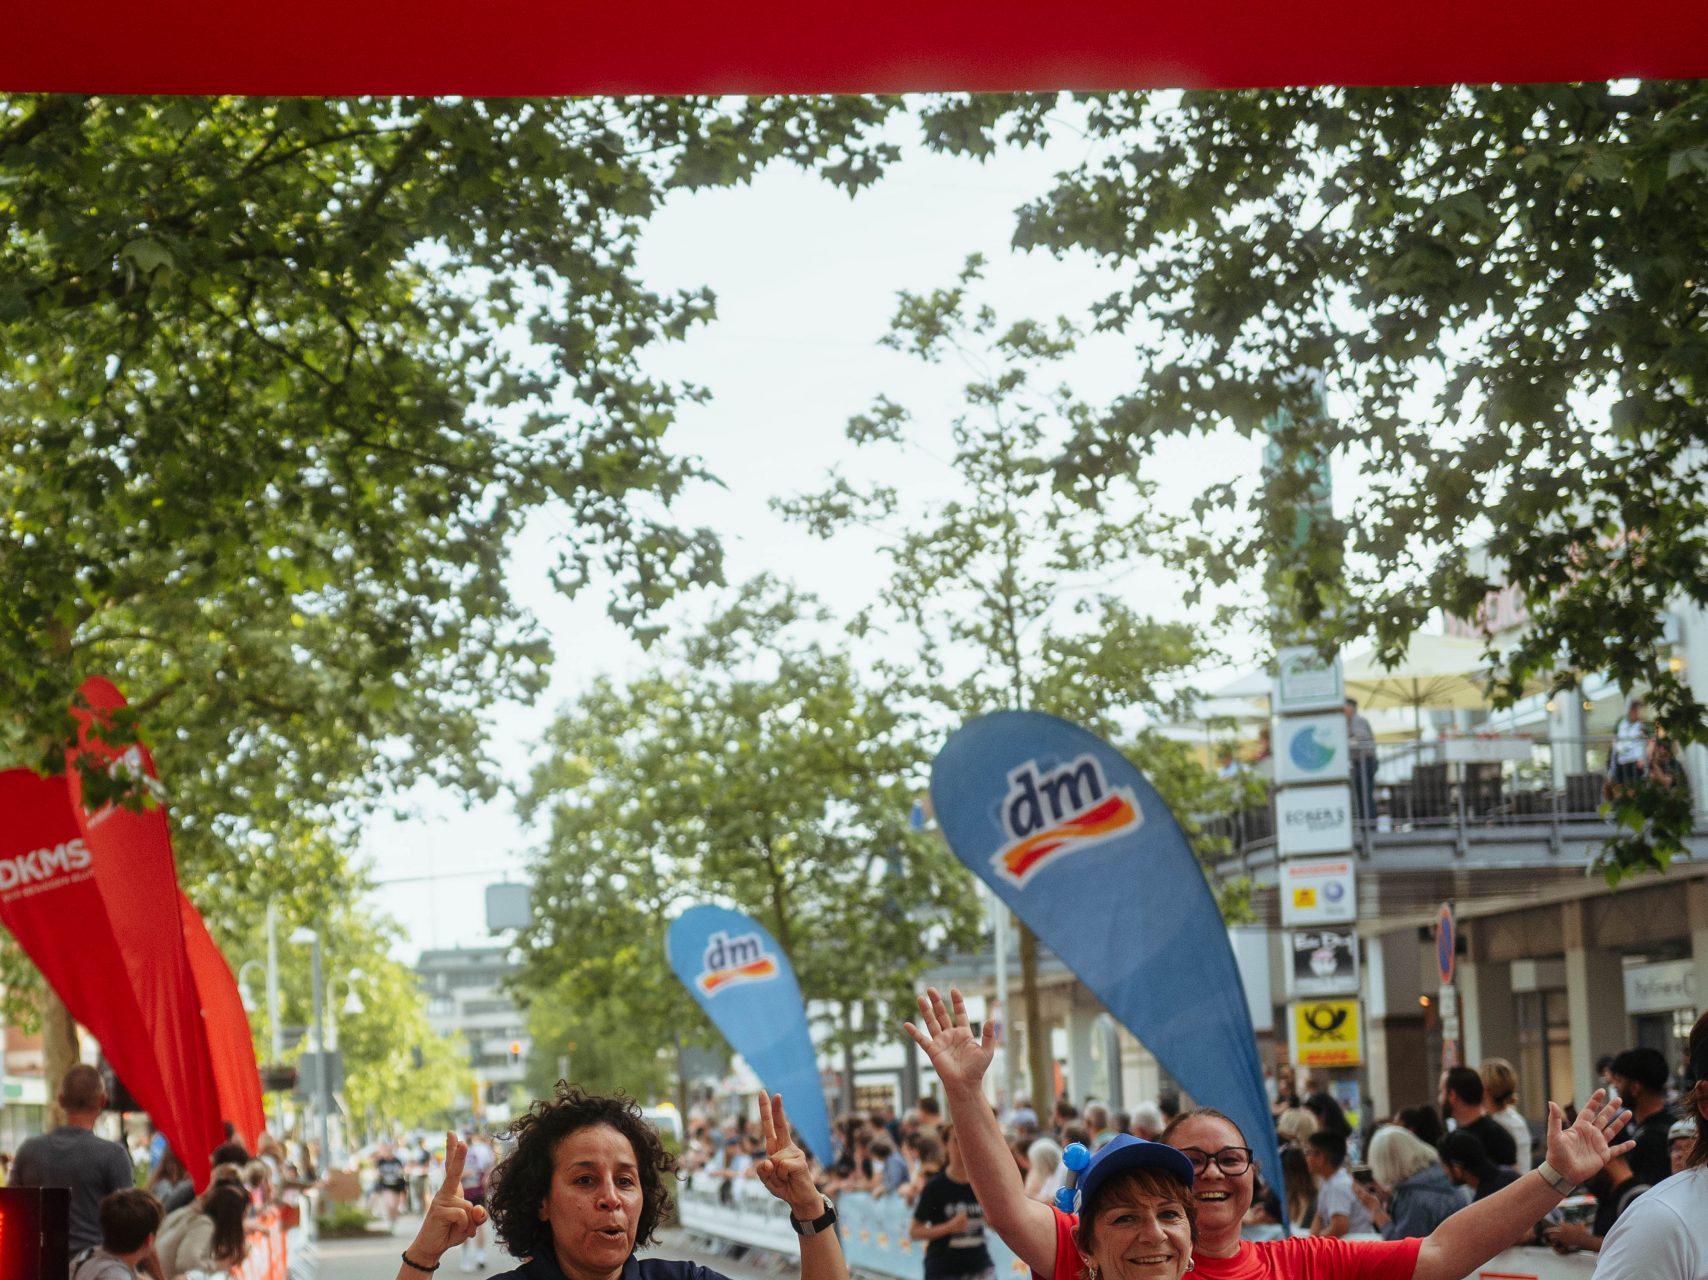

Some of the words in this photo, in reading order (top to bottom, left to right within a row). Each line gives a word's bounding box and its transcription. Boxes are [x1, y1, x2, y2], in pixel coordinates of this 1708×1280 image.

[1009, 761, 1102, 837] dm
[0, 838, 91, 890] DKMS
[709, 938, 759, 971] dm
